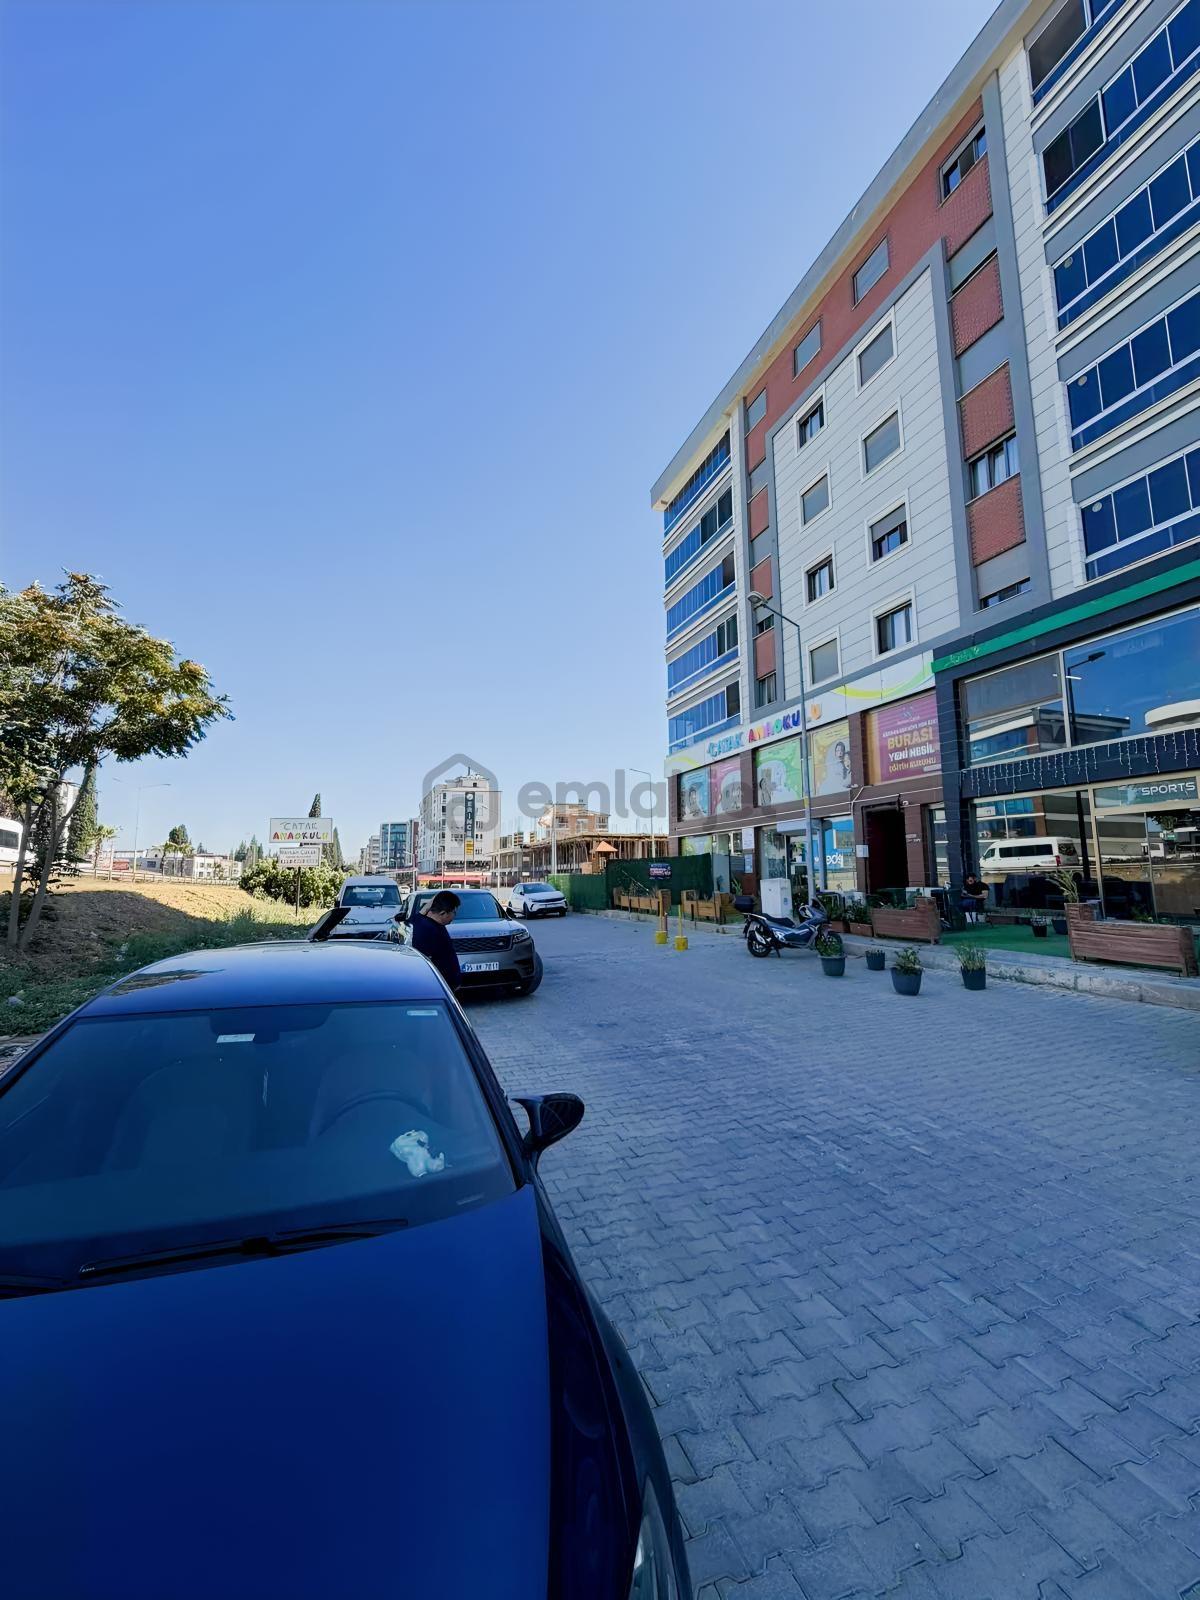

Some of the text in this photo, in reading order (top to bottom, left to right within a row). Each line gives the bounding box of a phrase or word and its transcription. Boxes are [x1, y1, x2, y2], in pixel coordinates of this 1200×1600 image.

[748, 703, 822, 743] ANAOKUU
[887, 726, 933, 750] BURASI
[1141, 781, 1196, 796] SPORTS
